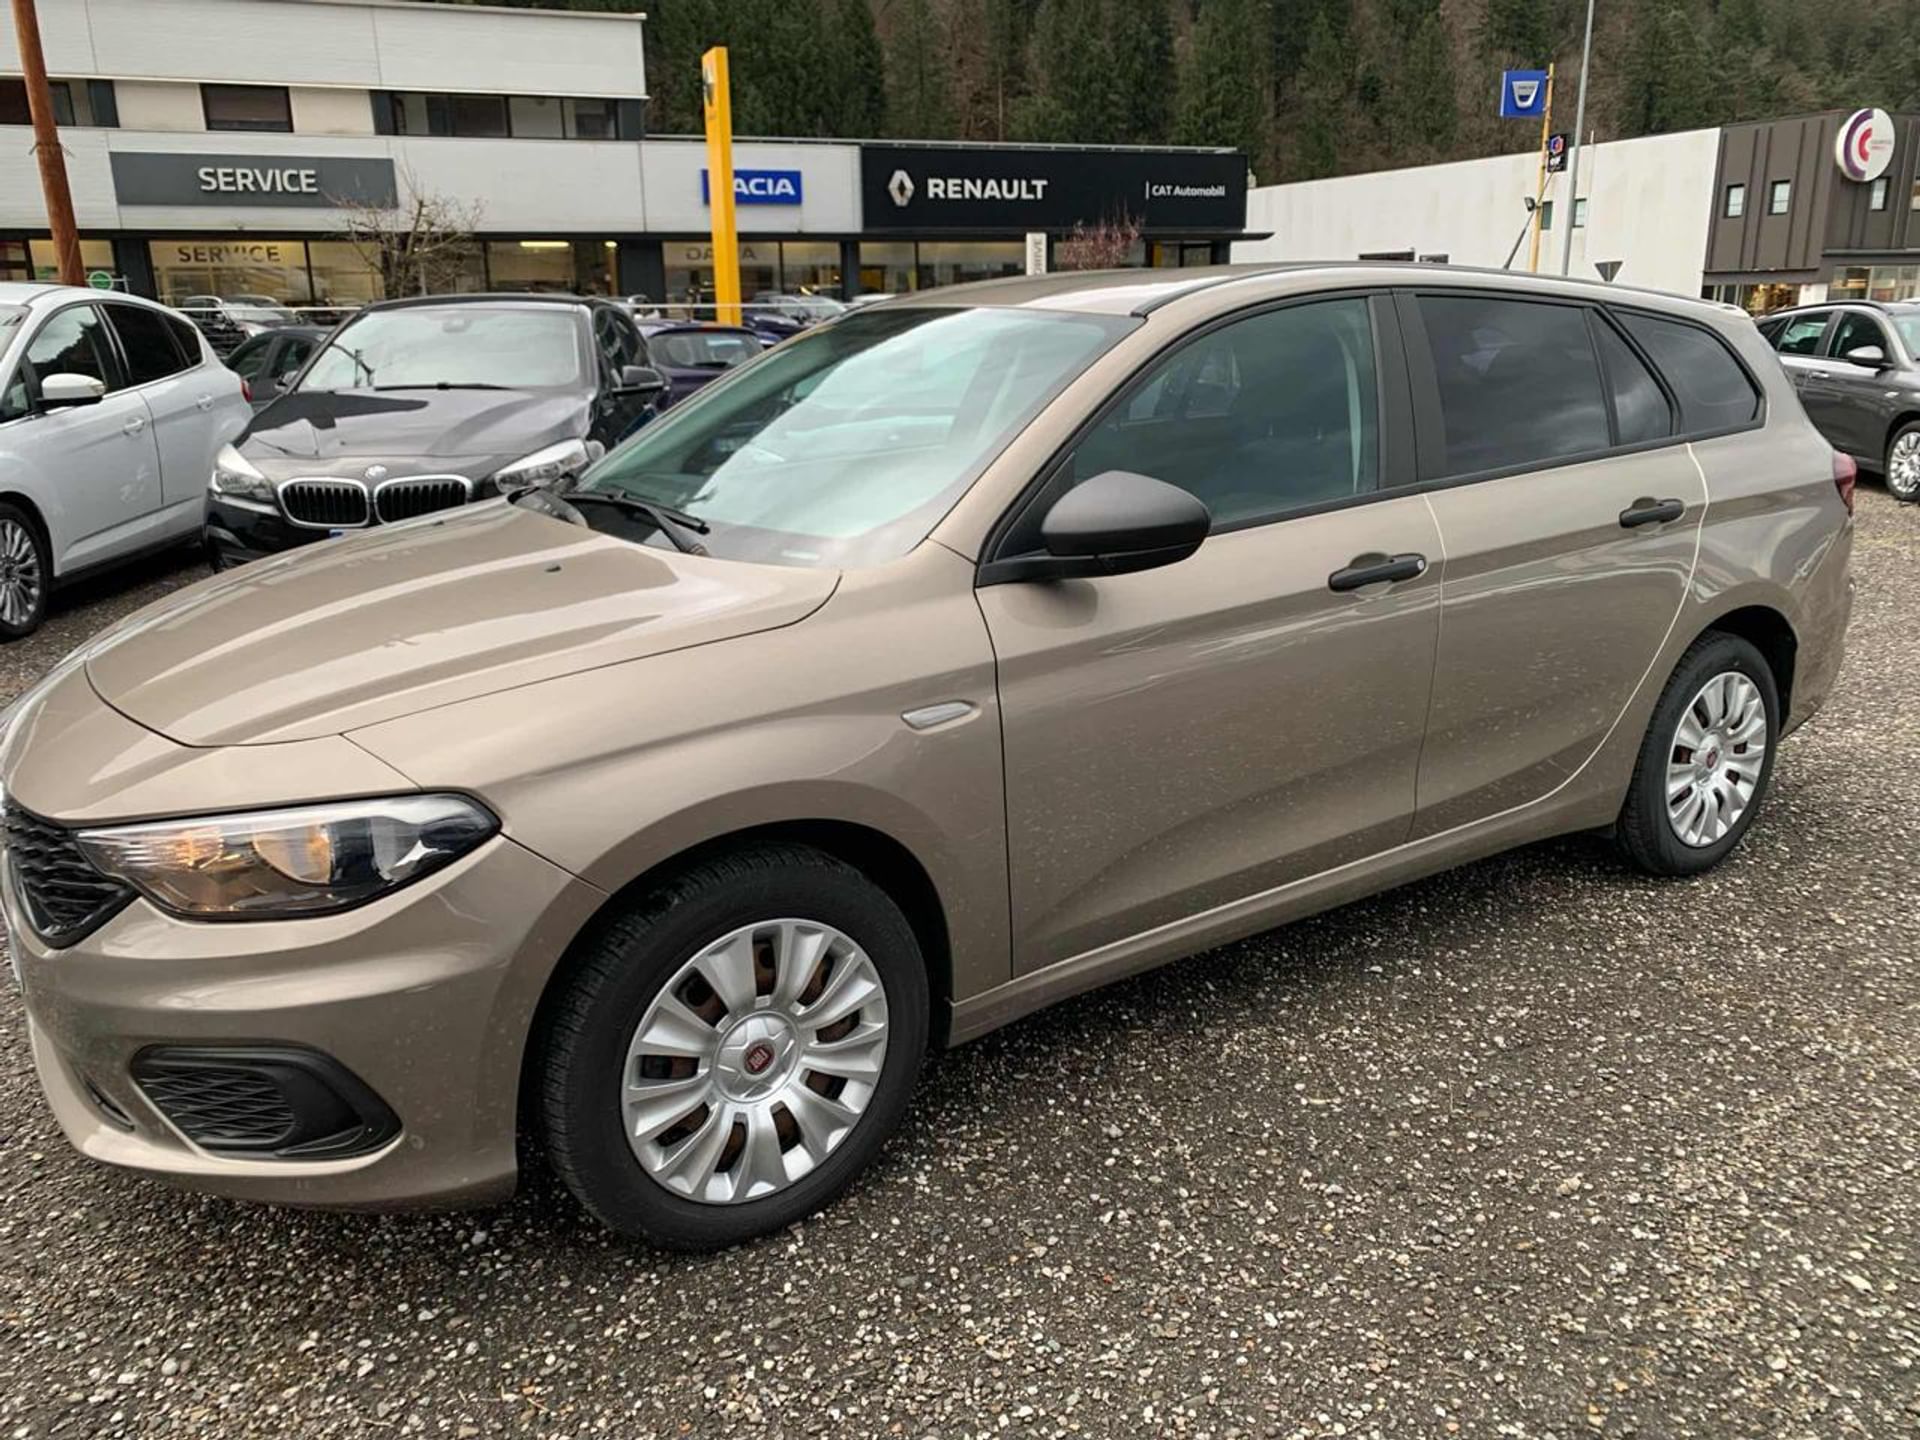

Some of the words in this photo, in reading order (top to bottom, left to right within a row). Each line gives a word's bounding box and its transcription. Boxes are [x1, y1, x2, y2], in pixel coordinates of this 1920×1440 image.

[198, 167, 318, 192] SERVICE
[733, 178, 795, 195] ACIA
[927, 178, 1048, 199] RENAULT
[1151, 185, 1173, 196] CAT
[1173, 185, 1226, 196] Automobili
